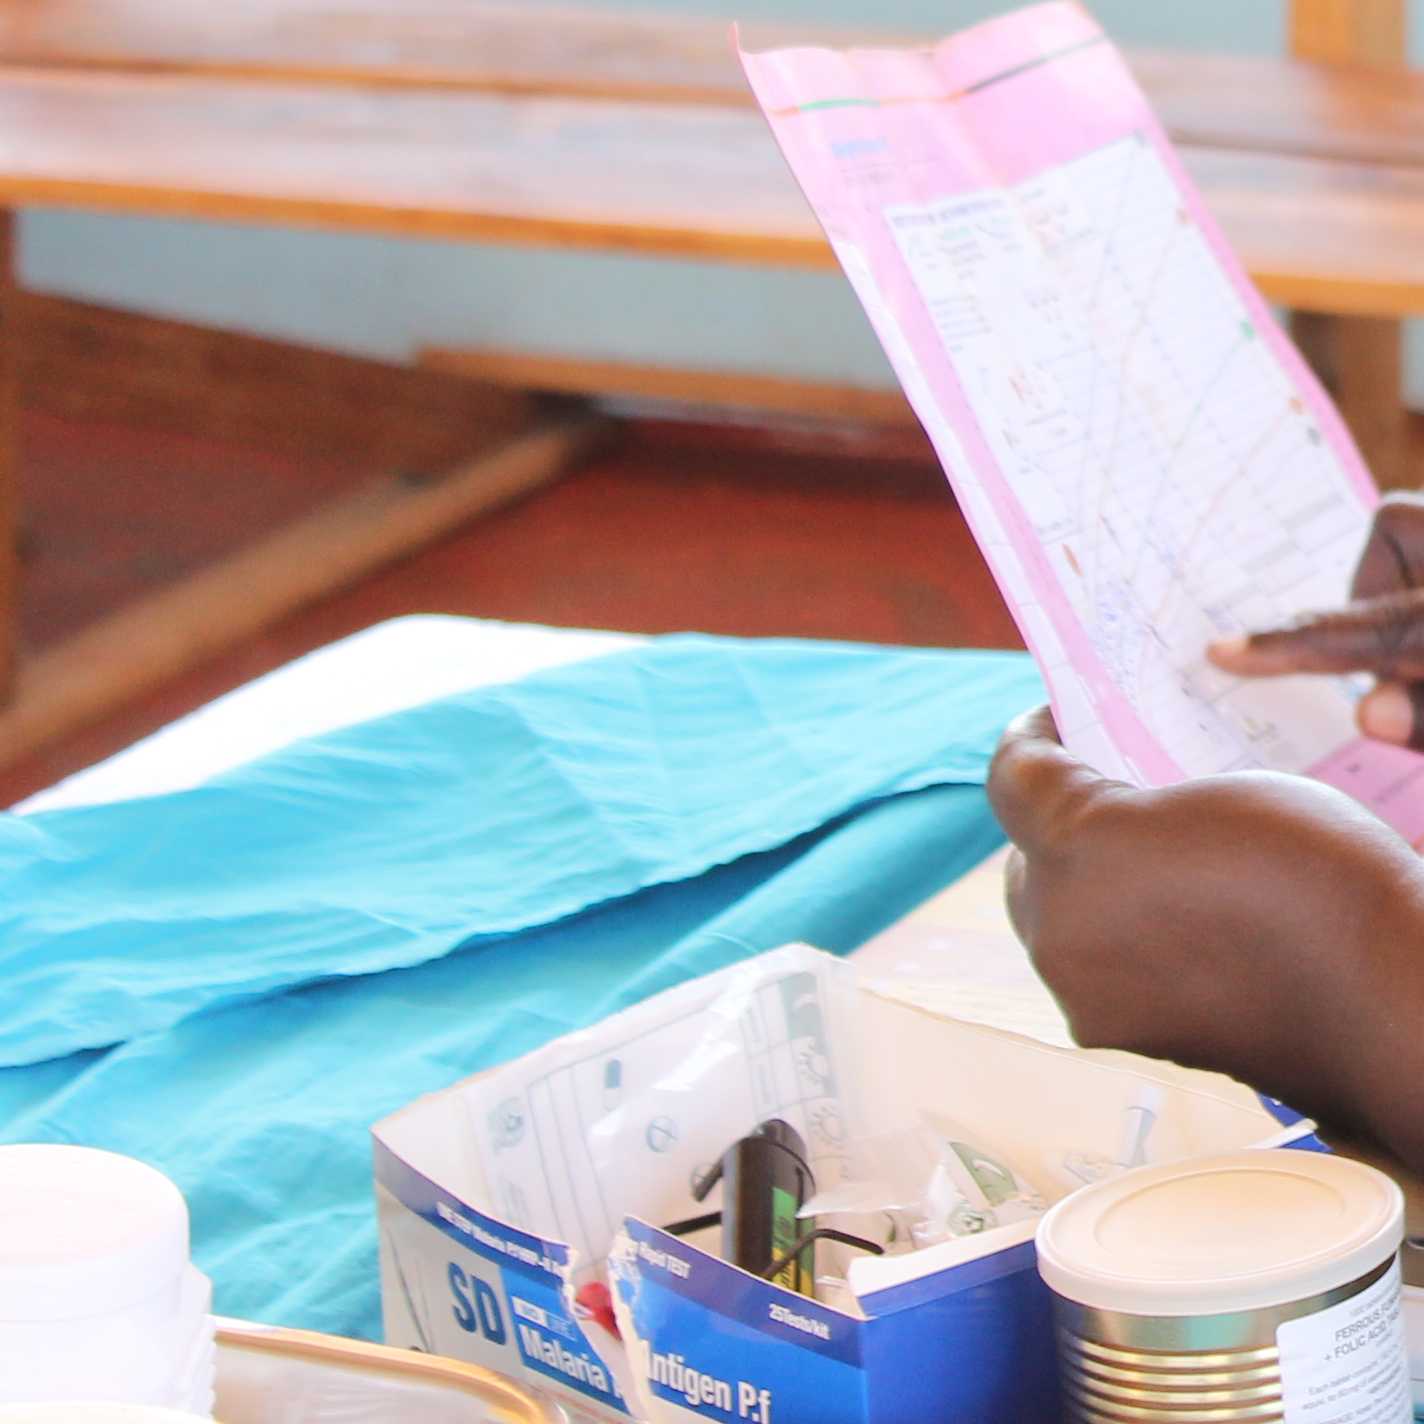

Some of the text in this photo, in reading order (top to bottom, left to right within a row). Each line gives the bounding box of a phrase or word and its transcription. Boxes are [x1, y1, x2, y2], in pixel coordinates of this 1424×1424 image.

[448, 1261, 507, 1346] SD
[1334, 1309, 1381, 1342] FERROUS
[518, 1323, 609, 1393] Malaria
[737, 1380, 772, 1424] P.f
[1334, 1336, 1366, 1359] FOLIC
